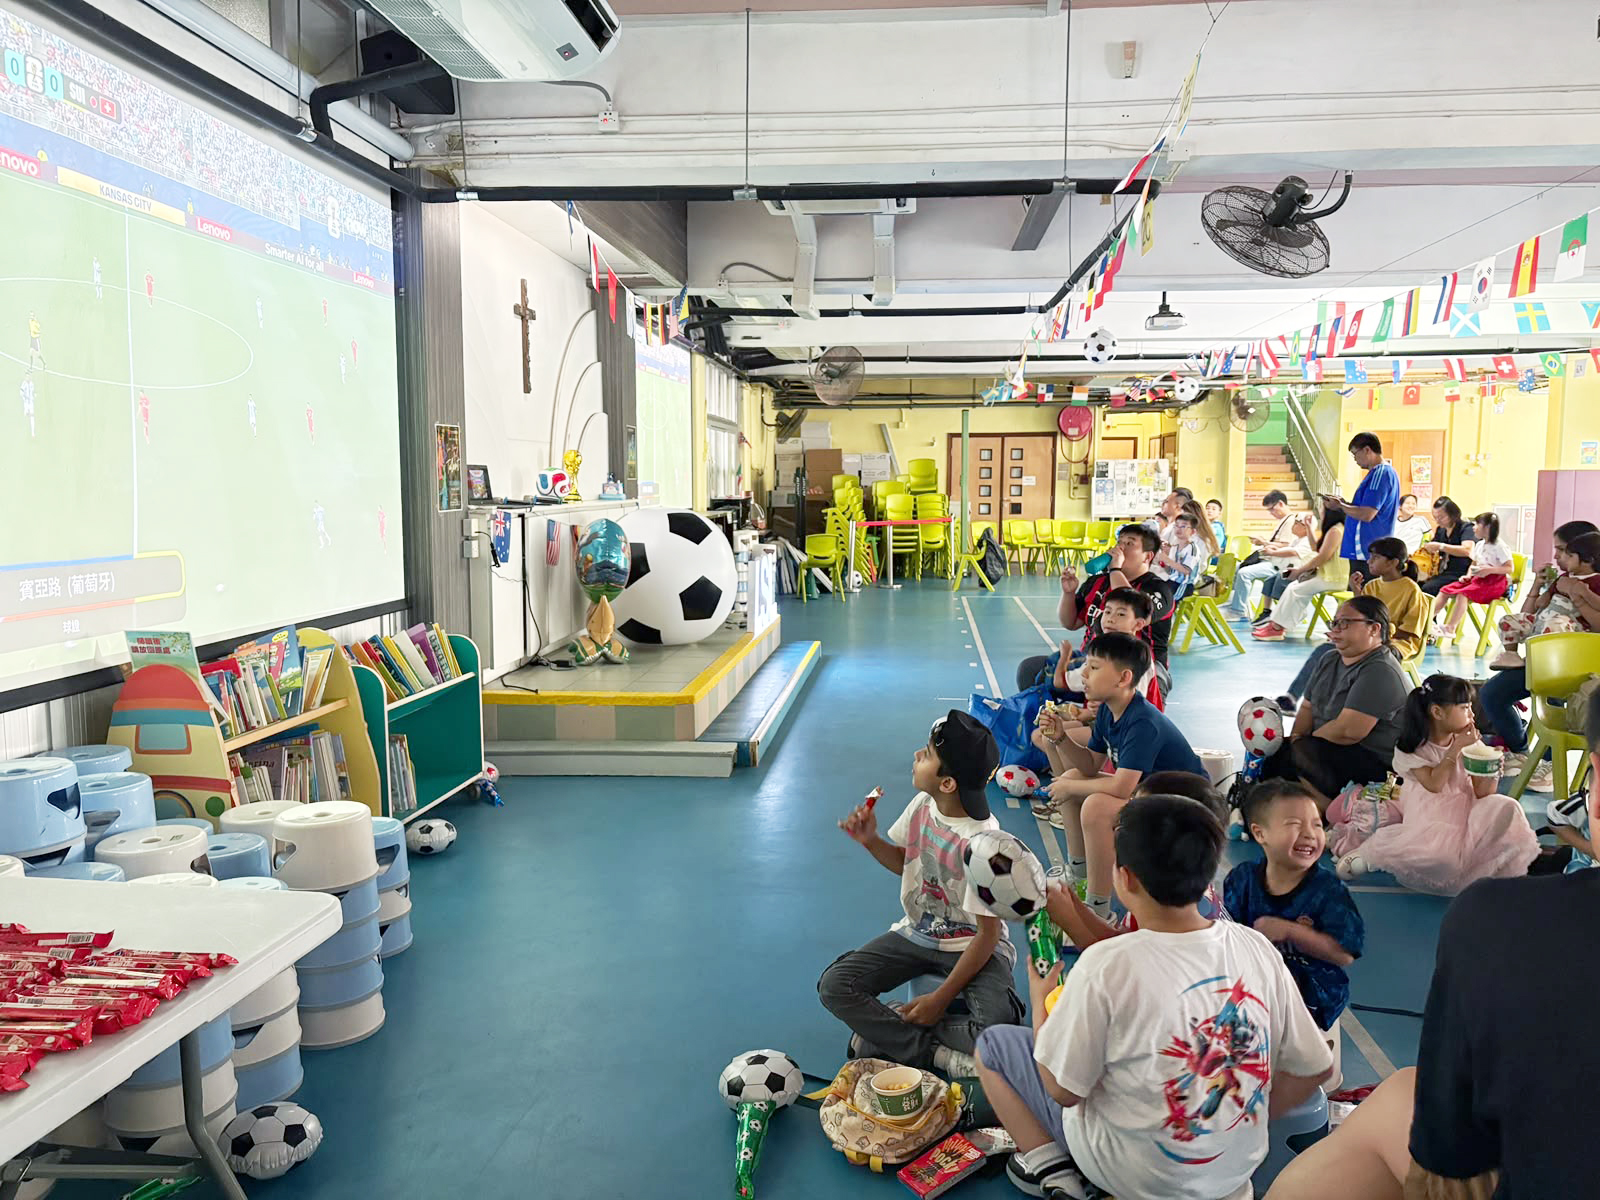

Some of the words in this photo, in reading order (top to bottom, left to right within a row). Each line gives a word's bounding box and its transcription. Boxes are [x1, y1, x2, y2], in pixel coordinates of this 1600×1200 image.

[11, 57, 19, 76] 0
[50, 74, 58, 92] 0
[69, 81, 86, 105] SUI
[0, 152, 39, 177] novo
[99, 184, 133, 206] KANSAS
[134, 198, 152, 212] CITY
[197, 218, 231, 241] Lenovo
[265, 242, 295, 261] Smarter
[296, 253, 304, 265] AI
[314, 261, 324, 273] all
[19, 576, 62, 602] 賓亞路
[67, 571, 115, 598] (葡萄牙)
